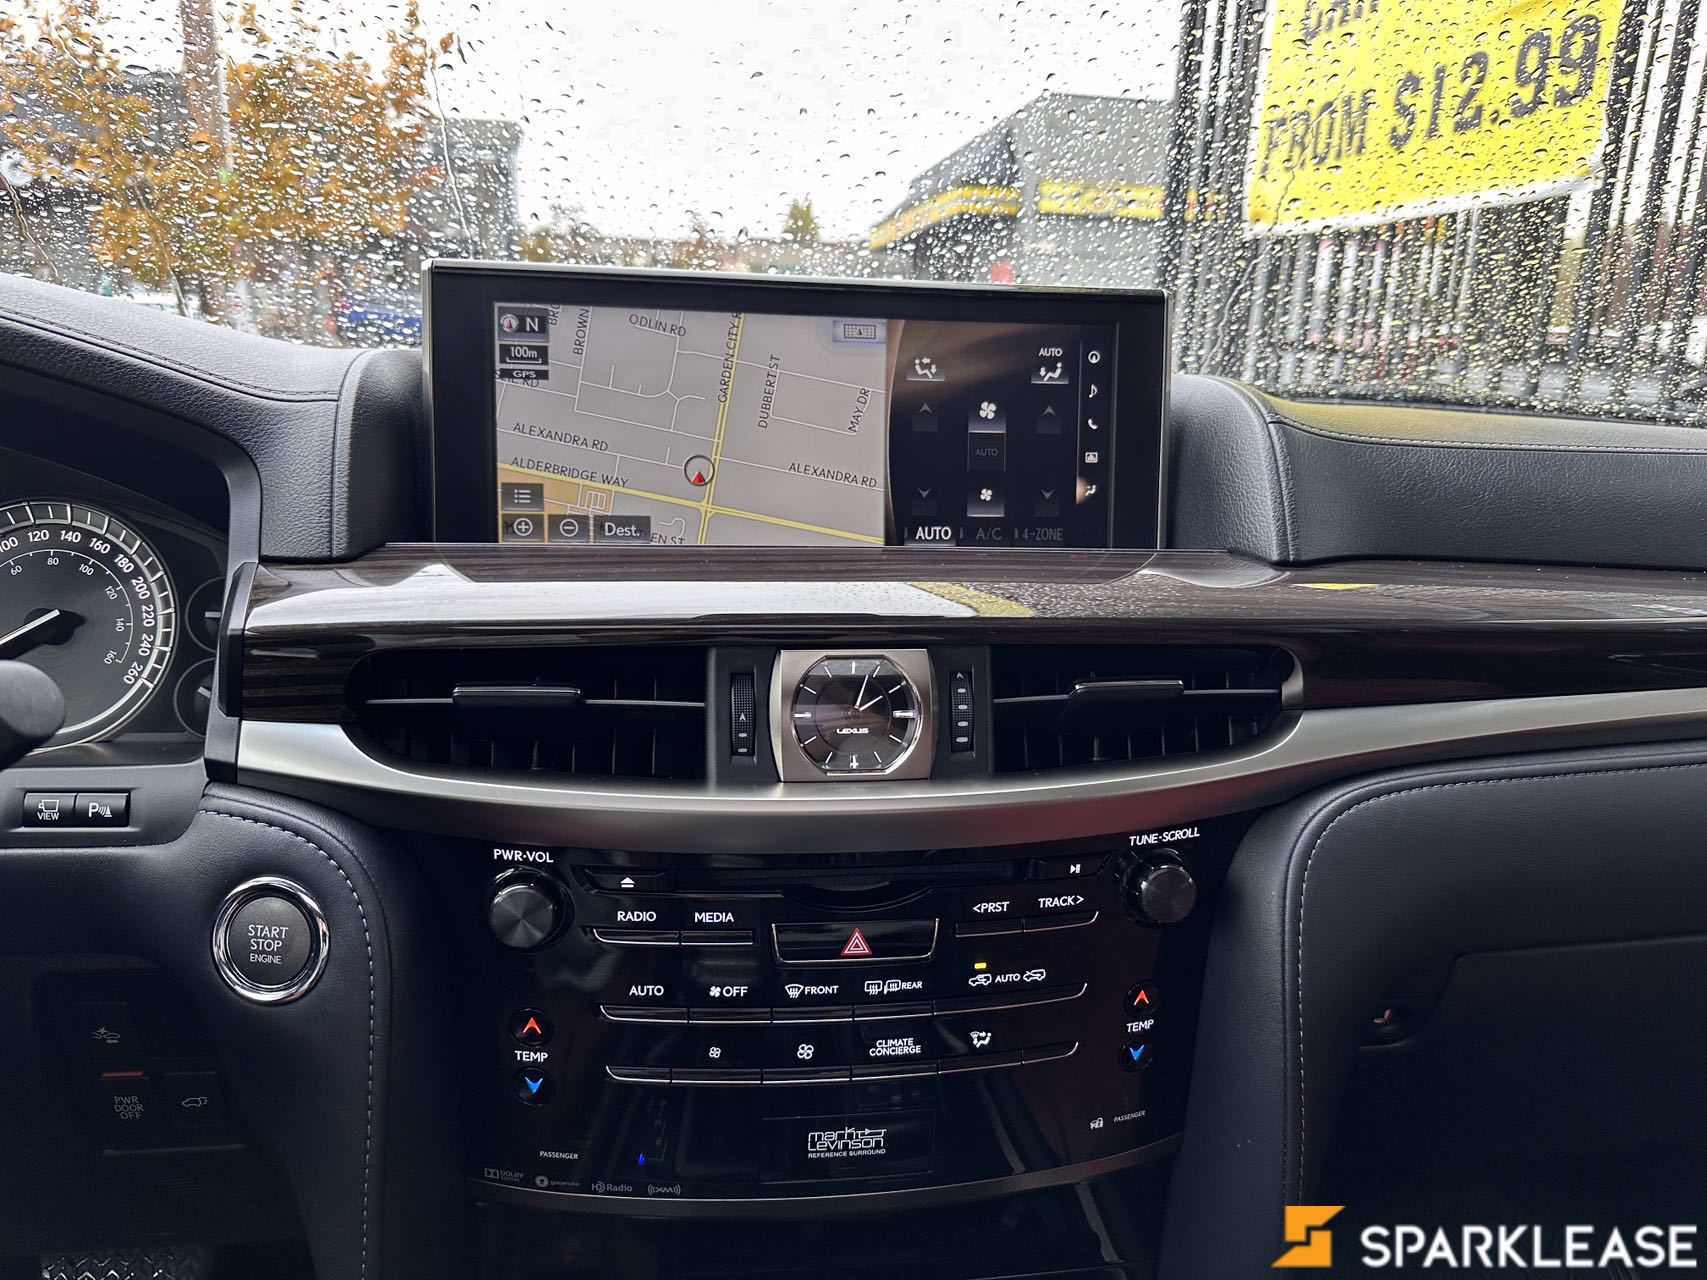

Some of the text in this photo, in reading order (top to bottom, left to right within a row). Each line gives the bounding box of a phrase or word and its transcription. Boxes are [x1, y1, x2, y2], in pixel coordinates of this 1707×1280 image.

[1261, 90, 1375, 175] FROM
[526, 317, 539, 332] N
[628, 313, 687, 337] ODLIN RD
[573, 308, 591, 355] BROWN
[510, 347, 538, 358] 100m
[1038, 348, 1063, 357] AUTO
[717, 352, 734, 403] GARDEN
[726, 320, 740, 351] CITY
[512, 370, 537, 378] GPS
[758, 354, 780, 429] DUBBERT ST
[848, 387, 871, 433] MAY DR
[512, 423, 609, 451] ALEXANDRA RD
[975, 448, 999, 457] AUTO
[511, 457, 629, 488] ALDERBRIDGE WAY
[788, 463, 878, 488] ALEXANDRA RD
[28, 530, 49, 542] 120
[604, 522, 641, 537] Dest.
[915, 527, 952, 540] AUTO
[976, 528, 1003, 540] A/C
[1022, 528, 1063, 541] 4-ZONE
[60, 530, 82, 543] 140
[89, 538, 110, 554] 160
[47, 557, 59, 566] 80
[114, 554, 135, 573] 180
[11, 565, 22, 576] 60
[79, 563, 94, 576] 100
[105, 586, 118, 600] 120
[131, 576, 150, 600] 200
[142, 604, 155, 627] 220
[115, 617, 125, 632] 140
[138, 635, 154, 656] 240
[104, 650, 118, 664] 160
[123, 661, 144, 684] 260
[37, 812, 60, 820] VIEW
[617, 911, 657, 922] RADIO
[694, 912, 735, 923] MEDIA
[247, 924, 289, 939] START
[250, 938, 282, 952] STOP
[249, 953, 282, 964] ENGINE
[995, 973, 1021, 983] AUTO
[629, 985, 665, 996] AUTO
[722, 986, 748, 997] OFF
[804, 985, 839, 995] FRONT
[901, 981, 923, 990] REAR
[1126, 1019, 1155, 1033] TEMP
[876, 1037, 914, 1048] CLIMATE
[514, 1050, 549, 1063] TEMP
[869, 1045, 921, 1056] CONCIERGE
[114, 1096, 139, 1104] PWR
[114, 1104, 144, 1112] DOOR
[120, 1111, 143, 1120] OFF
[1113, 1110, 1146, 1123] PASSENGER
[539, 1150, 579, 1160] PASSENGER
[849, 1149, 886, 1157] SURROUND
[606, 1183, 633, 1193] Radio
